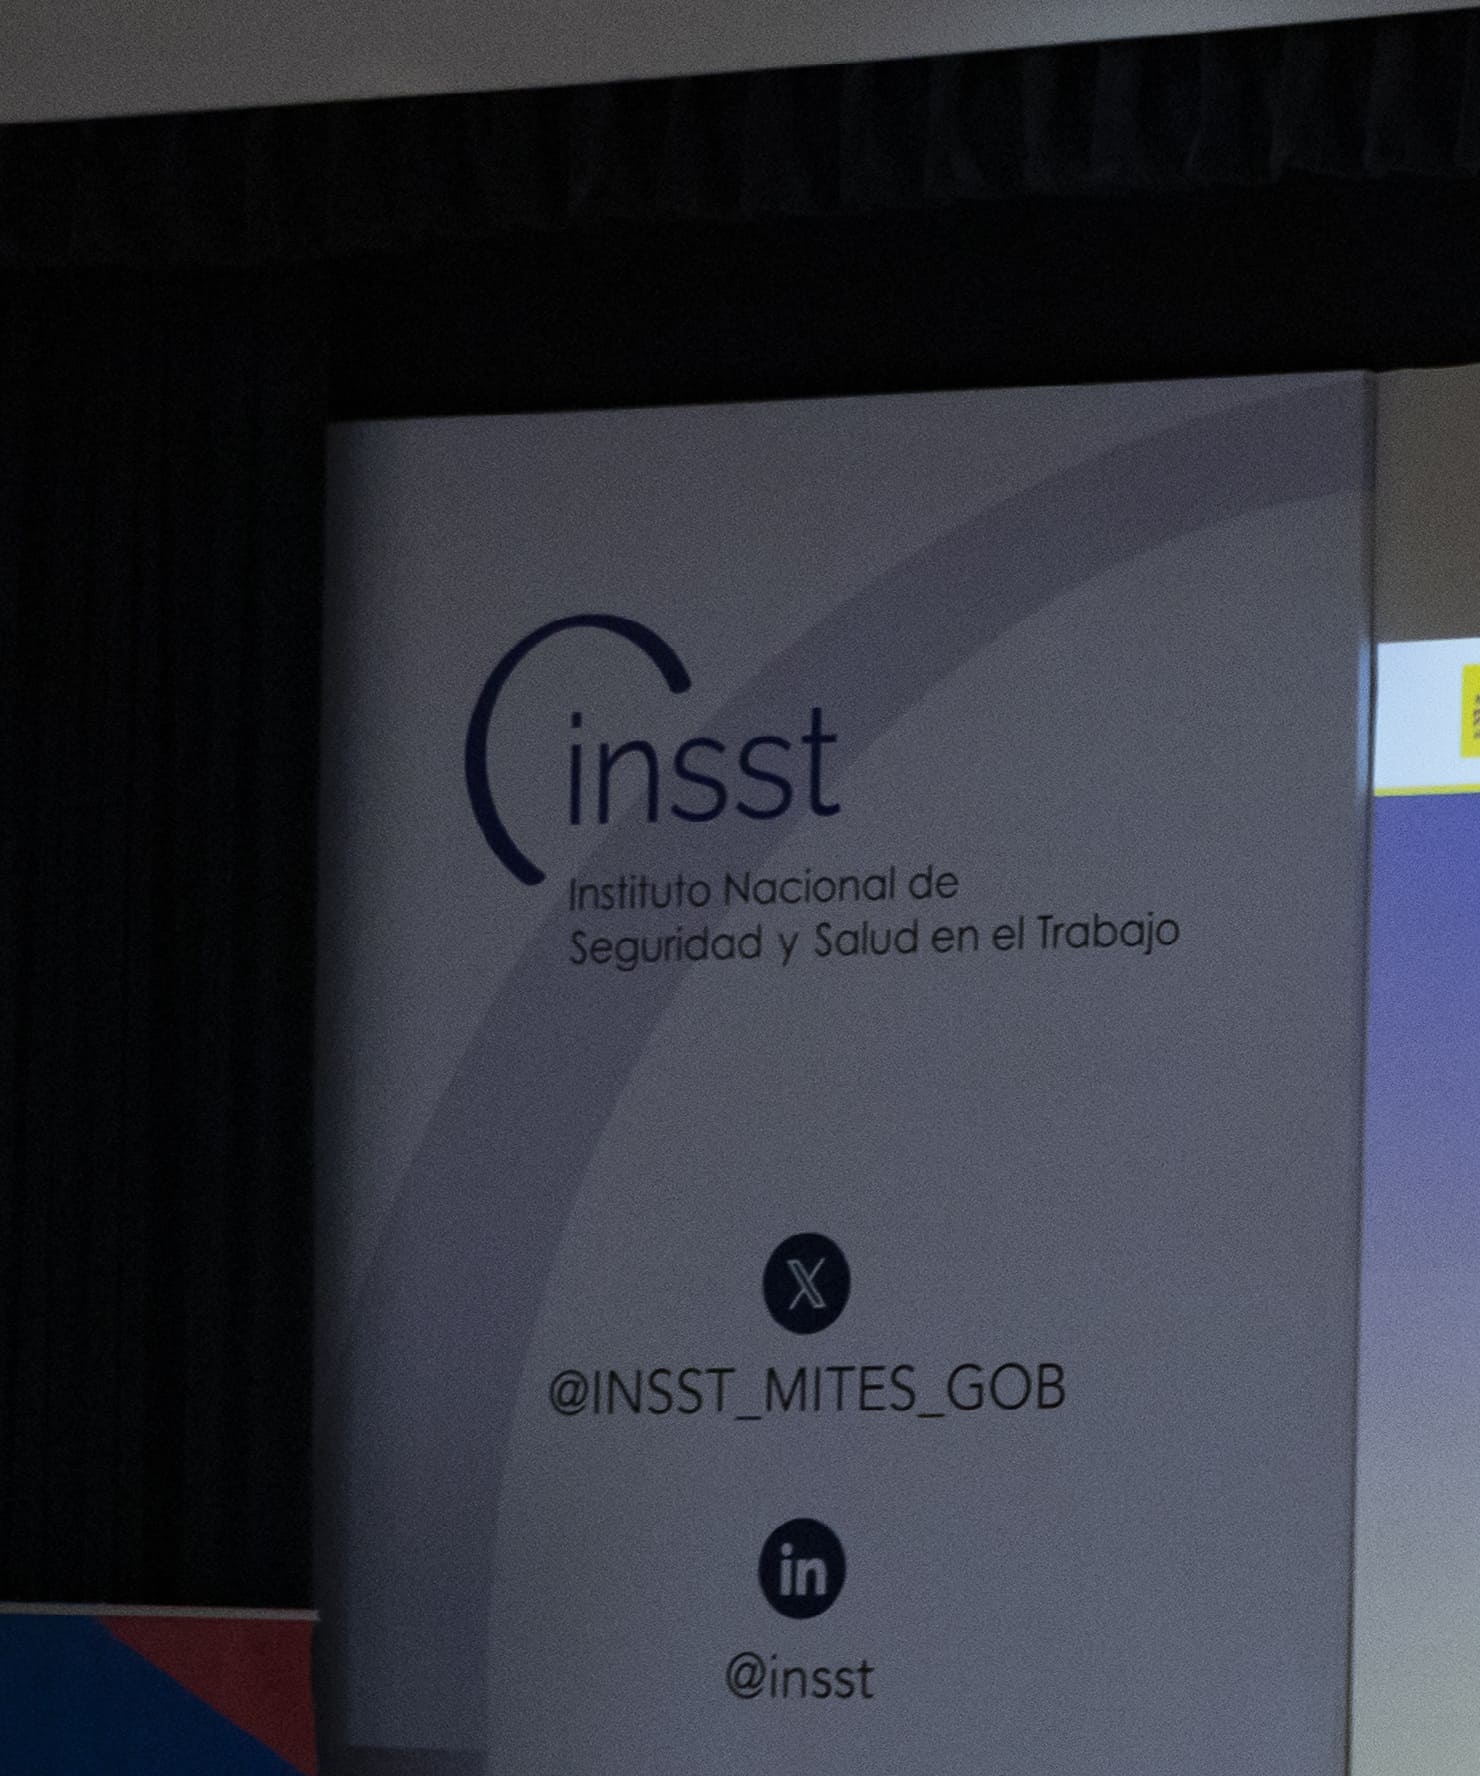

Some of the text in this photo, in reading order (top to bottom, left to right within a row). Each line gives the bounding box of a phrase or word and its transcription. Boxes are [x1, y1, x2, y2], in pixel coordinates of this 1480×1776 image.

[568, 706, 842, 825] insst
[568, 864, 960, 911] Instituto Nacional de
[569, 912, 1180, 972] Seguridad y Salud en el Trabajo
[550, 1363, 1066, 1421] @INSST_MITES_GOB
[726, 1651, 876, 1699] @insst
